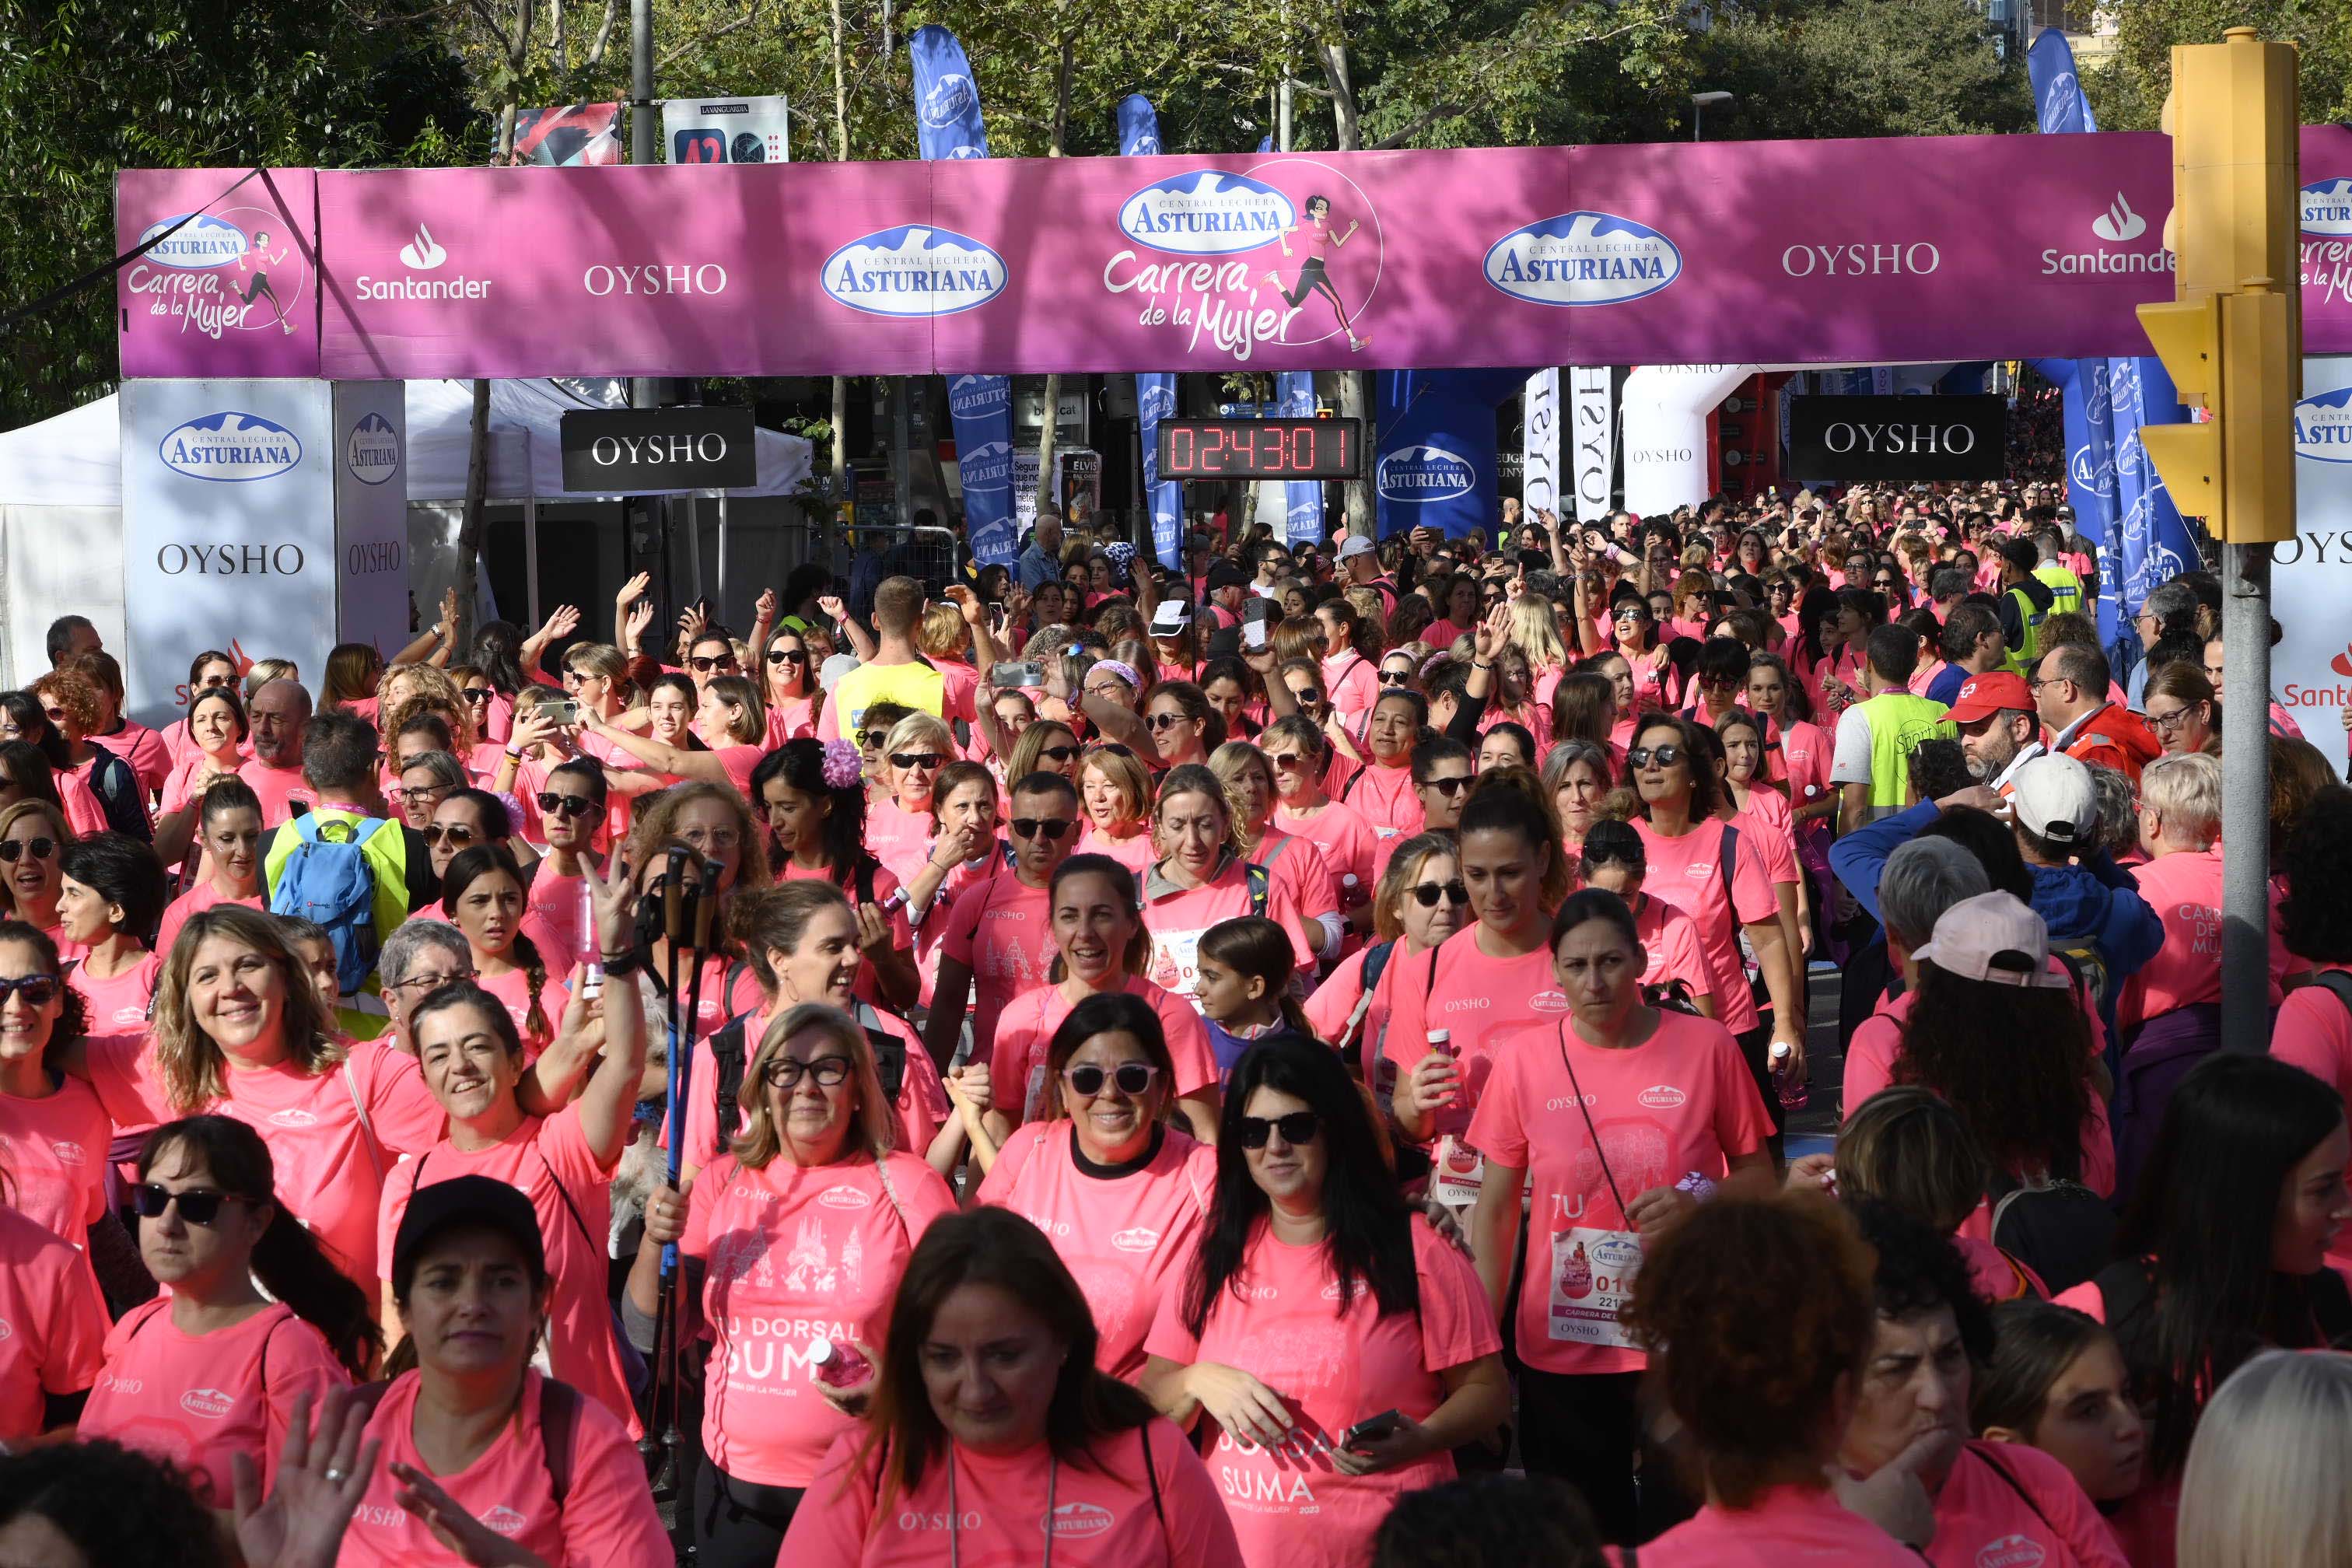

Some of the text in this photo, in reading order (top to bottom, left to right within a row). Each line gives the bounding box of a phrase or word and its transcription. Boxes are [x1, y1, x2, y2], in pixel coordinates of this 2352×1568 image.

[1159, 198, 1276, 208] CENTRAL LECHERA
[1132, 201, 1283, 233] ASTURIANA
[864, 256, 987, 265] CENTRAL LECHERA
[1529, 243, 1660, 254] CENTRAL LECHERA
[1782, 242, 1940, 277] OYSHO
[2042, 247, 2176, 274] Santande
[835, 260, 994, 293] ASTURIANA
[1104, 250, 1250, 293] Carrera
[1498, 247, 1667, 282] ASTURIANA
[128, 264, 219, 294] Carrera
[356, 275, 492, 299] Santander
[583, 263, 727, 296] OYSHO
[151, 291, 254, 339] de la Mujer
[1139, 288, 1304, 361] de la Mujer
[592, 432, 727, 466] OYSHO
[1825, 422, 1975, 453] OYSHO
[171, 437, 292, 464] ASTURIANA
[351, 439, 397, 467] ASTURIANA
[1633, 448, 1692, 464] OYSHO
[1073, 460, 1097, 471] ELVIS
[1015, 483, 1041, 492] quiere
[1381, 468, 1468, 489] ASTURIANA
[1016, 493, 1036, 502] mete
[157, 543, 304, 575] OYSHO
[348, 541, 401, 576] OYSHO
[2284, 684, 2352, 707] Sant
[1898, 725, 1932, 754] Sport
[986, 909, 1025, 921] OYSHO
[2179, 905, 2221, 922] CARR
[2196, 922, 2215, 937] DE
[1445, 997, 1491, 1013] OYSHO
[1547, 1094, 1596, 1111] OYSHO
[1641, 1093, 1682, 1103] ASTURIANA
[1551, 1192, 1584, 1219] TU
[1565, 1308, 1600, 1318] CARRERA
[752, 1318, 861, 1342] DORSAL
[1561, 1324, 1600, 1336] OYSHO
[1222, 1465, 1315, 1503] SUMA
[898, 1510, 982, 1532] OYSHO
[1299, 1505, 1320, 1514] 2023
